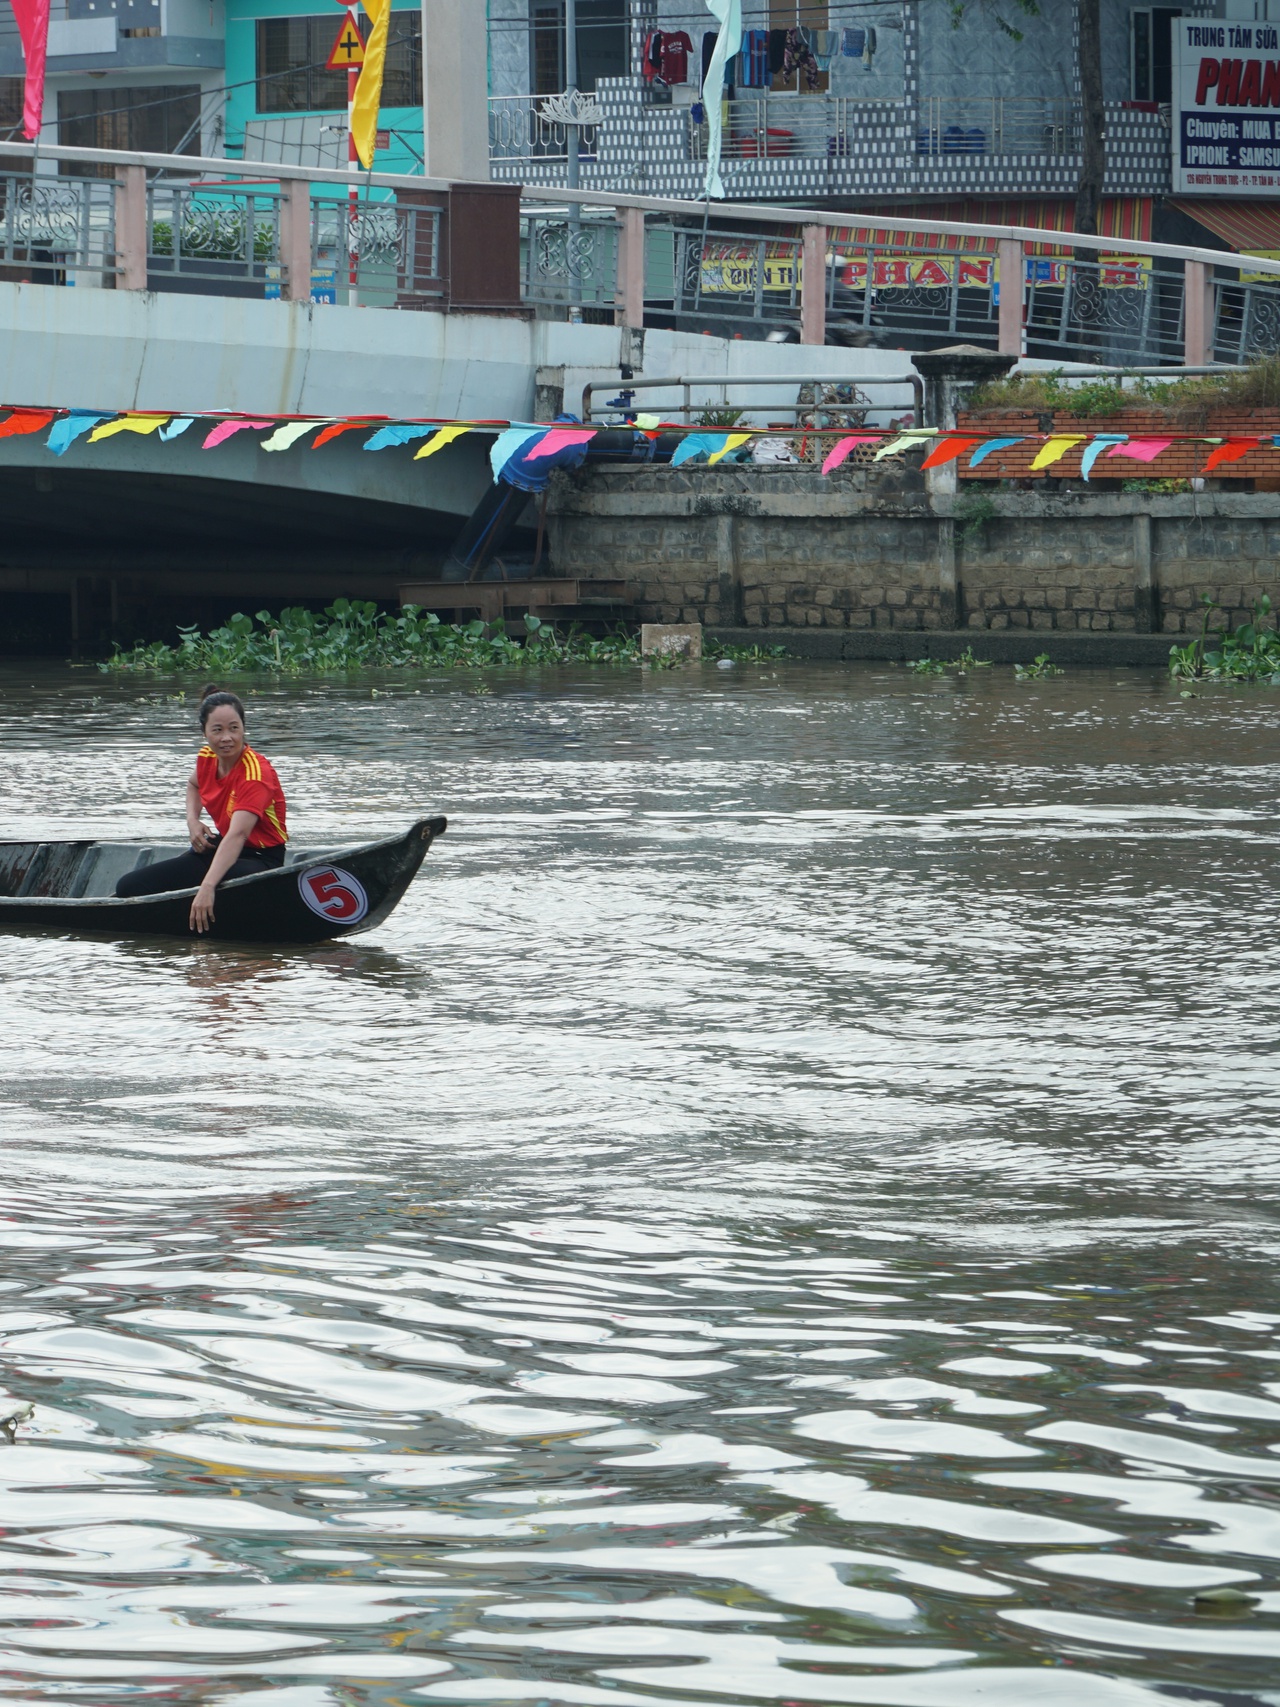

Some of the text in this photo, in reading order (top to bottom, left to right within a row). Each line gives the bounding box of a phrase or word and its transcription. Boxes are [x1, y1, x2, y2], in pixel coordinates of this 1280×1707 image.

[1187, 24, 1278, 49] TRUNG TÂM SỬA
[1186, 118, 1239, 140] Chuyên:
[1242, 120, 1272, 139] MUA
[1186, 145, 1230, 165] IPHONE
[841, 260, 994, 286] PHAN
[306, 869, 359, 919] 5
